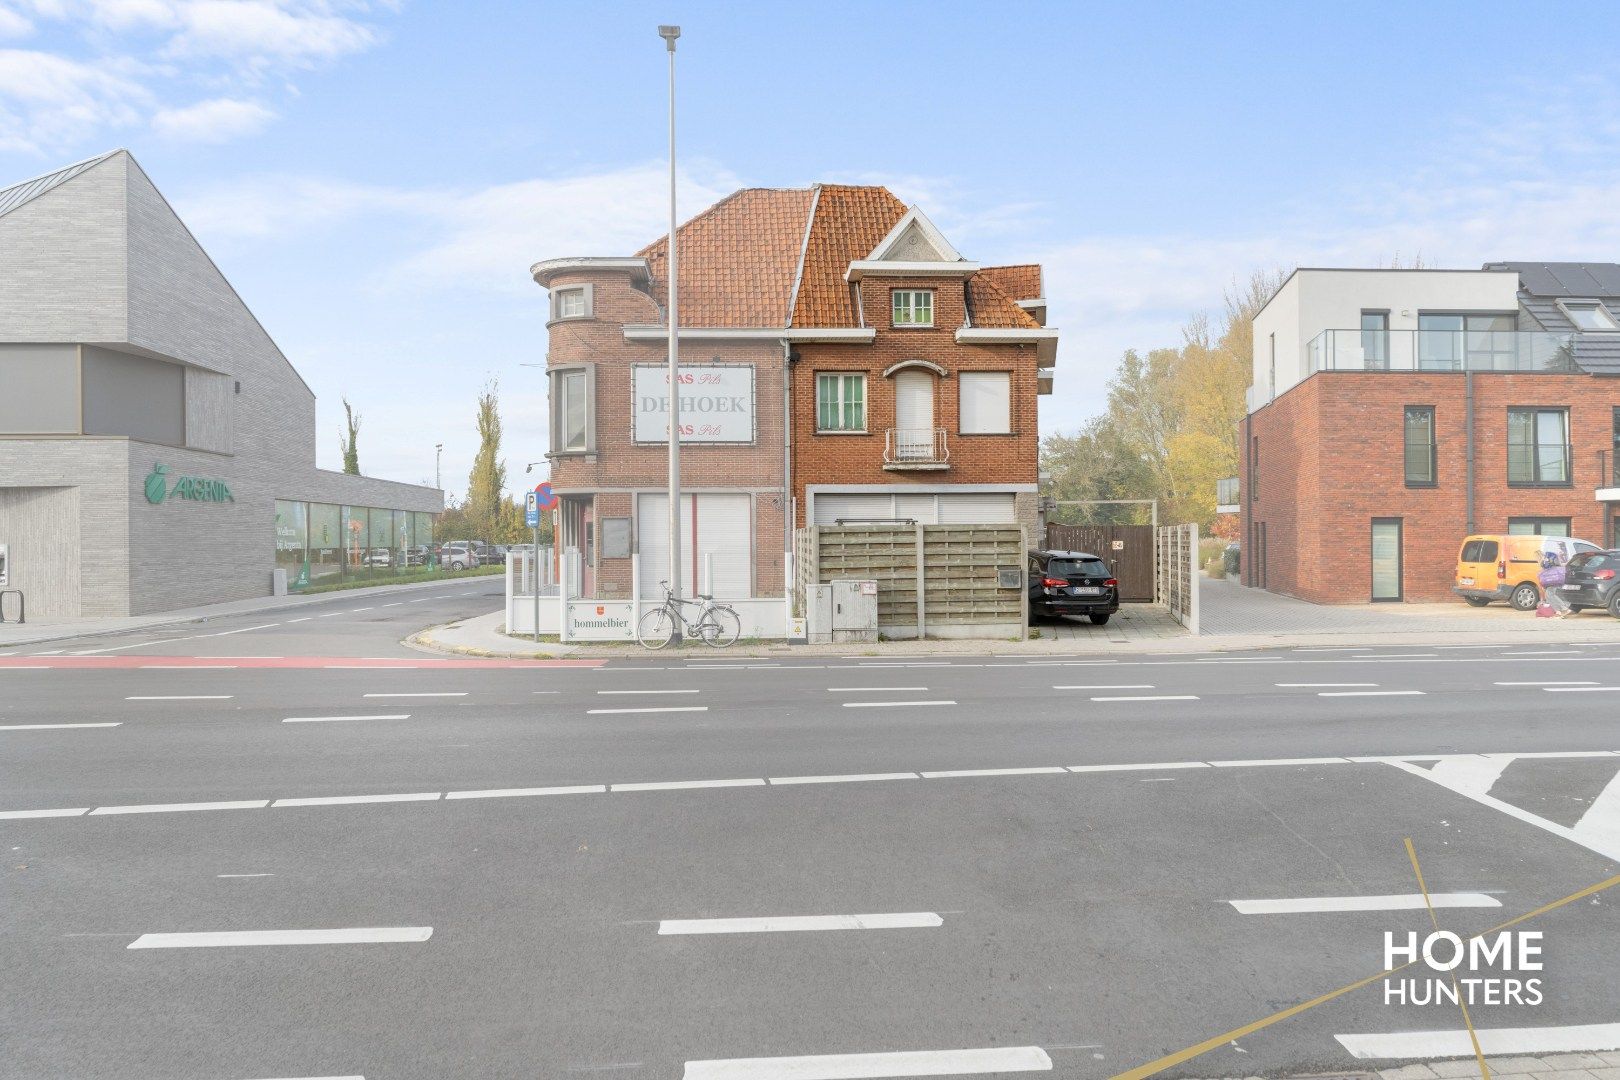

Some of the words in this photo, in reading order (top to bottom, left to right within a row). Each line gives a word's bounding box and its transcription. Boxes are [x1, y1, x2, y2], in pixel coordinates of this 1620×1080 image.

[697, 373, 722, 385] Pils
[678, 396, 747, 413] HOEK
[697, 424, 722, 436] Pils
[574, 618, 629, 629] hommelbier
